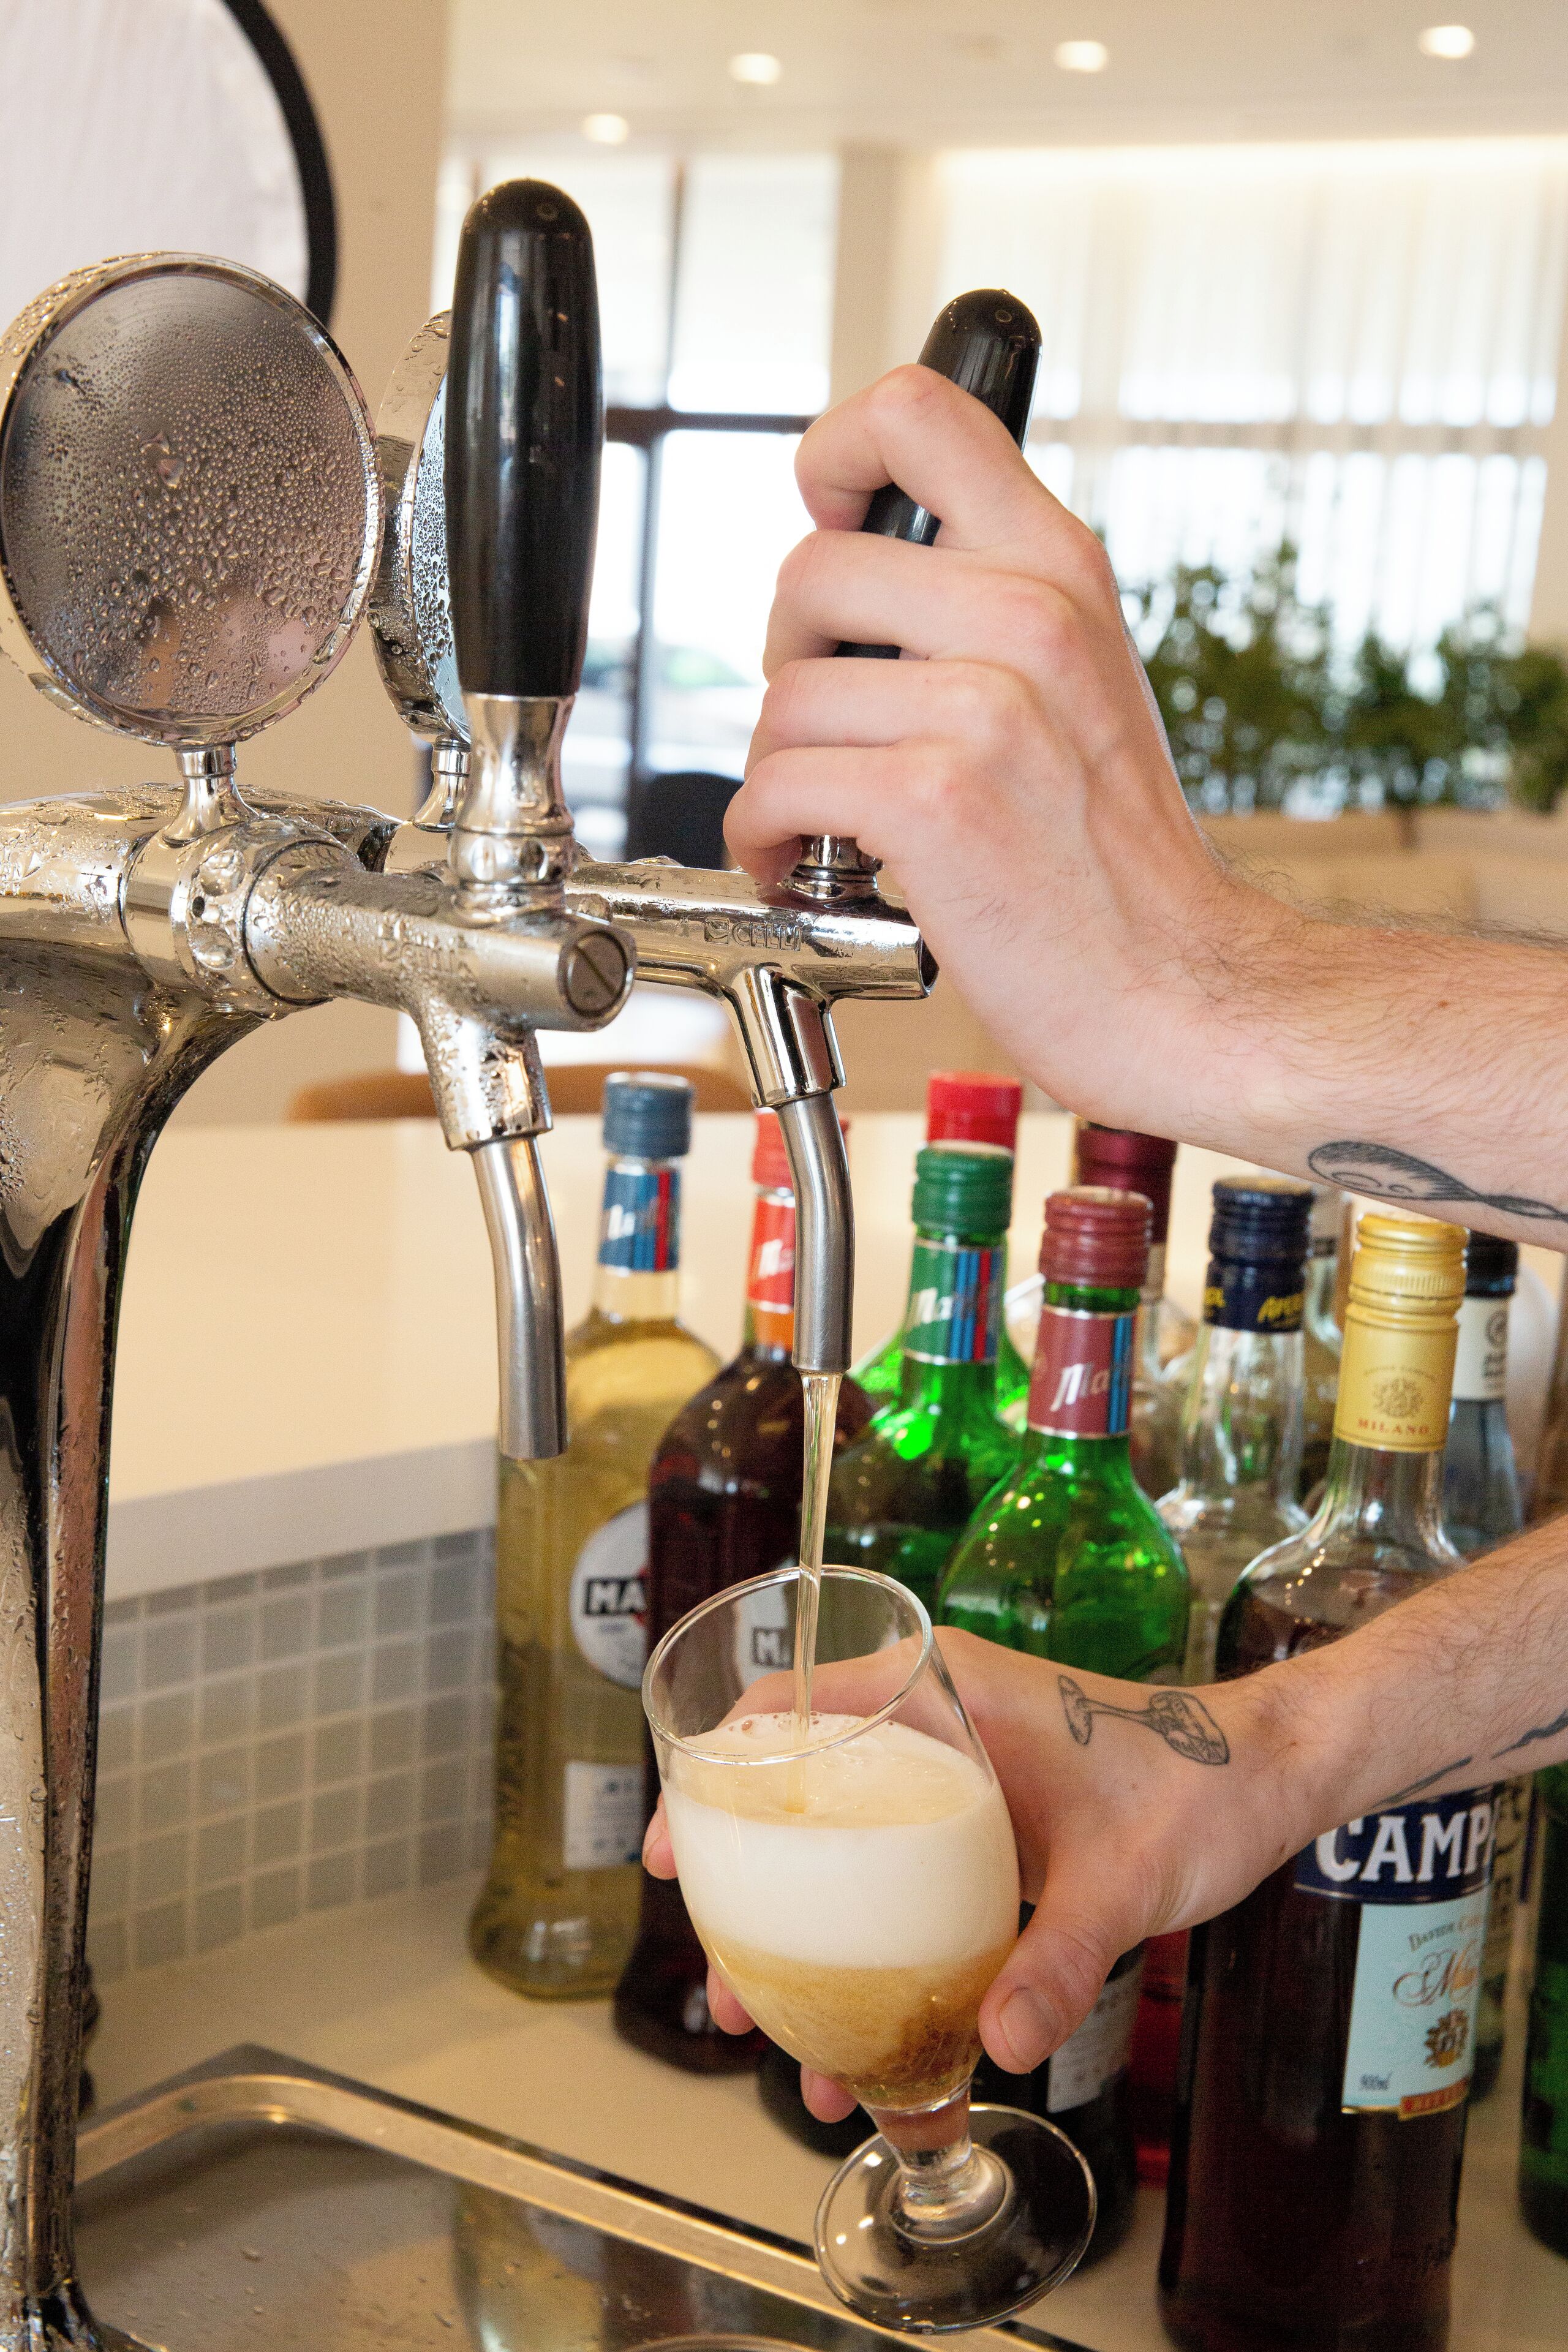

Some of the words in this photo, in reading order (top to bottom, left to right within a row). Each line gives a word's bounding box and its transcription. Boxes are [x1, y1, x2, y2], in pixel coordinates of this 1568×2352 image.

[733, 921, 802, 951] CELLI
[1357, 1417, 1430, 1435] MILANO
[588, 1581, 646, 1613] MA
